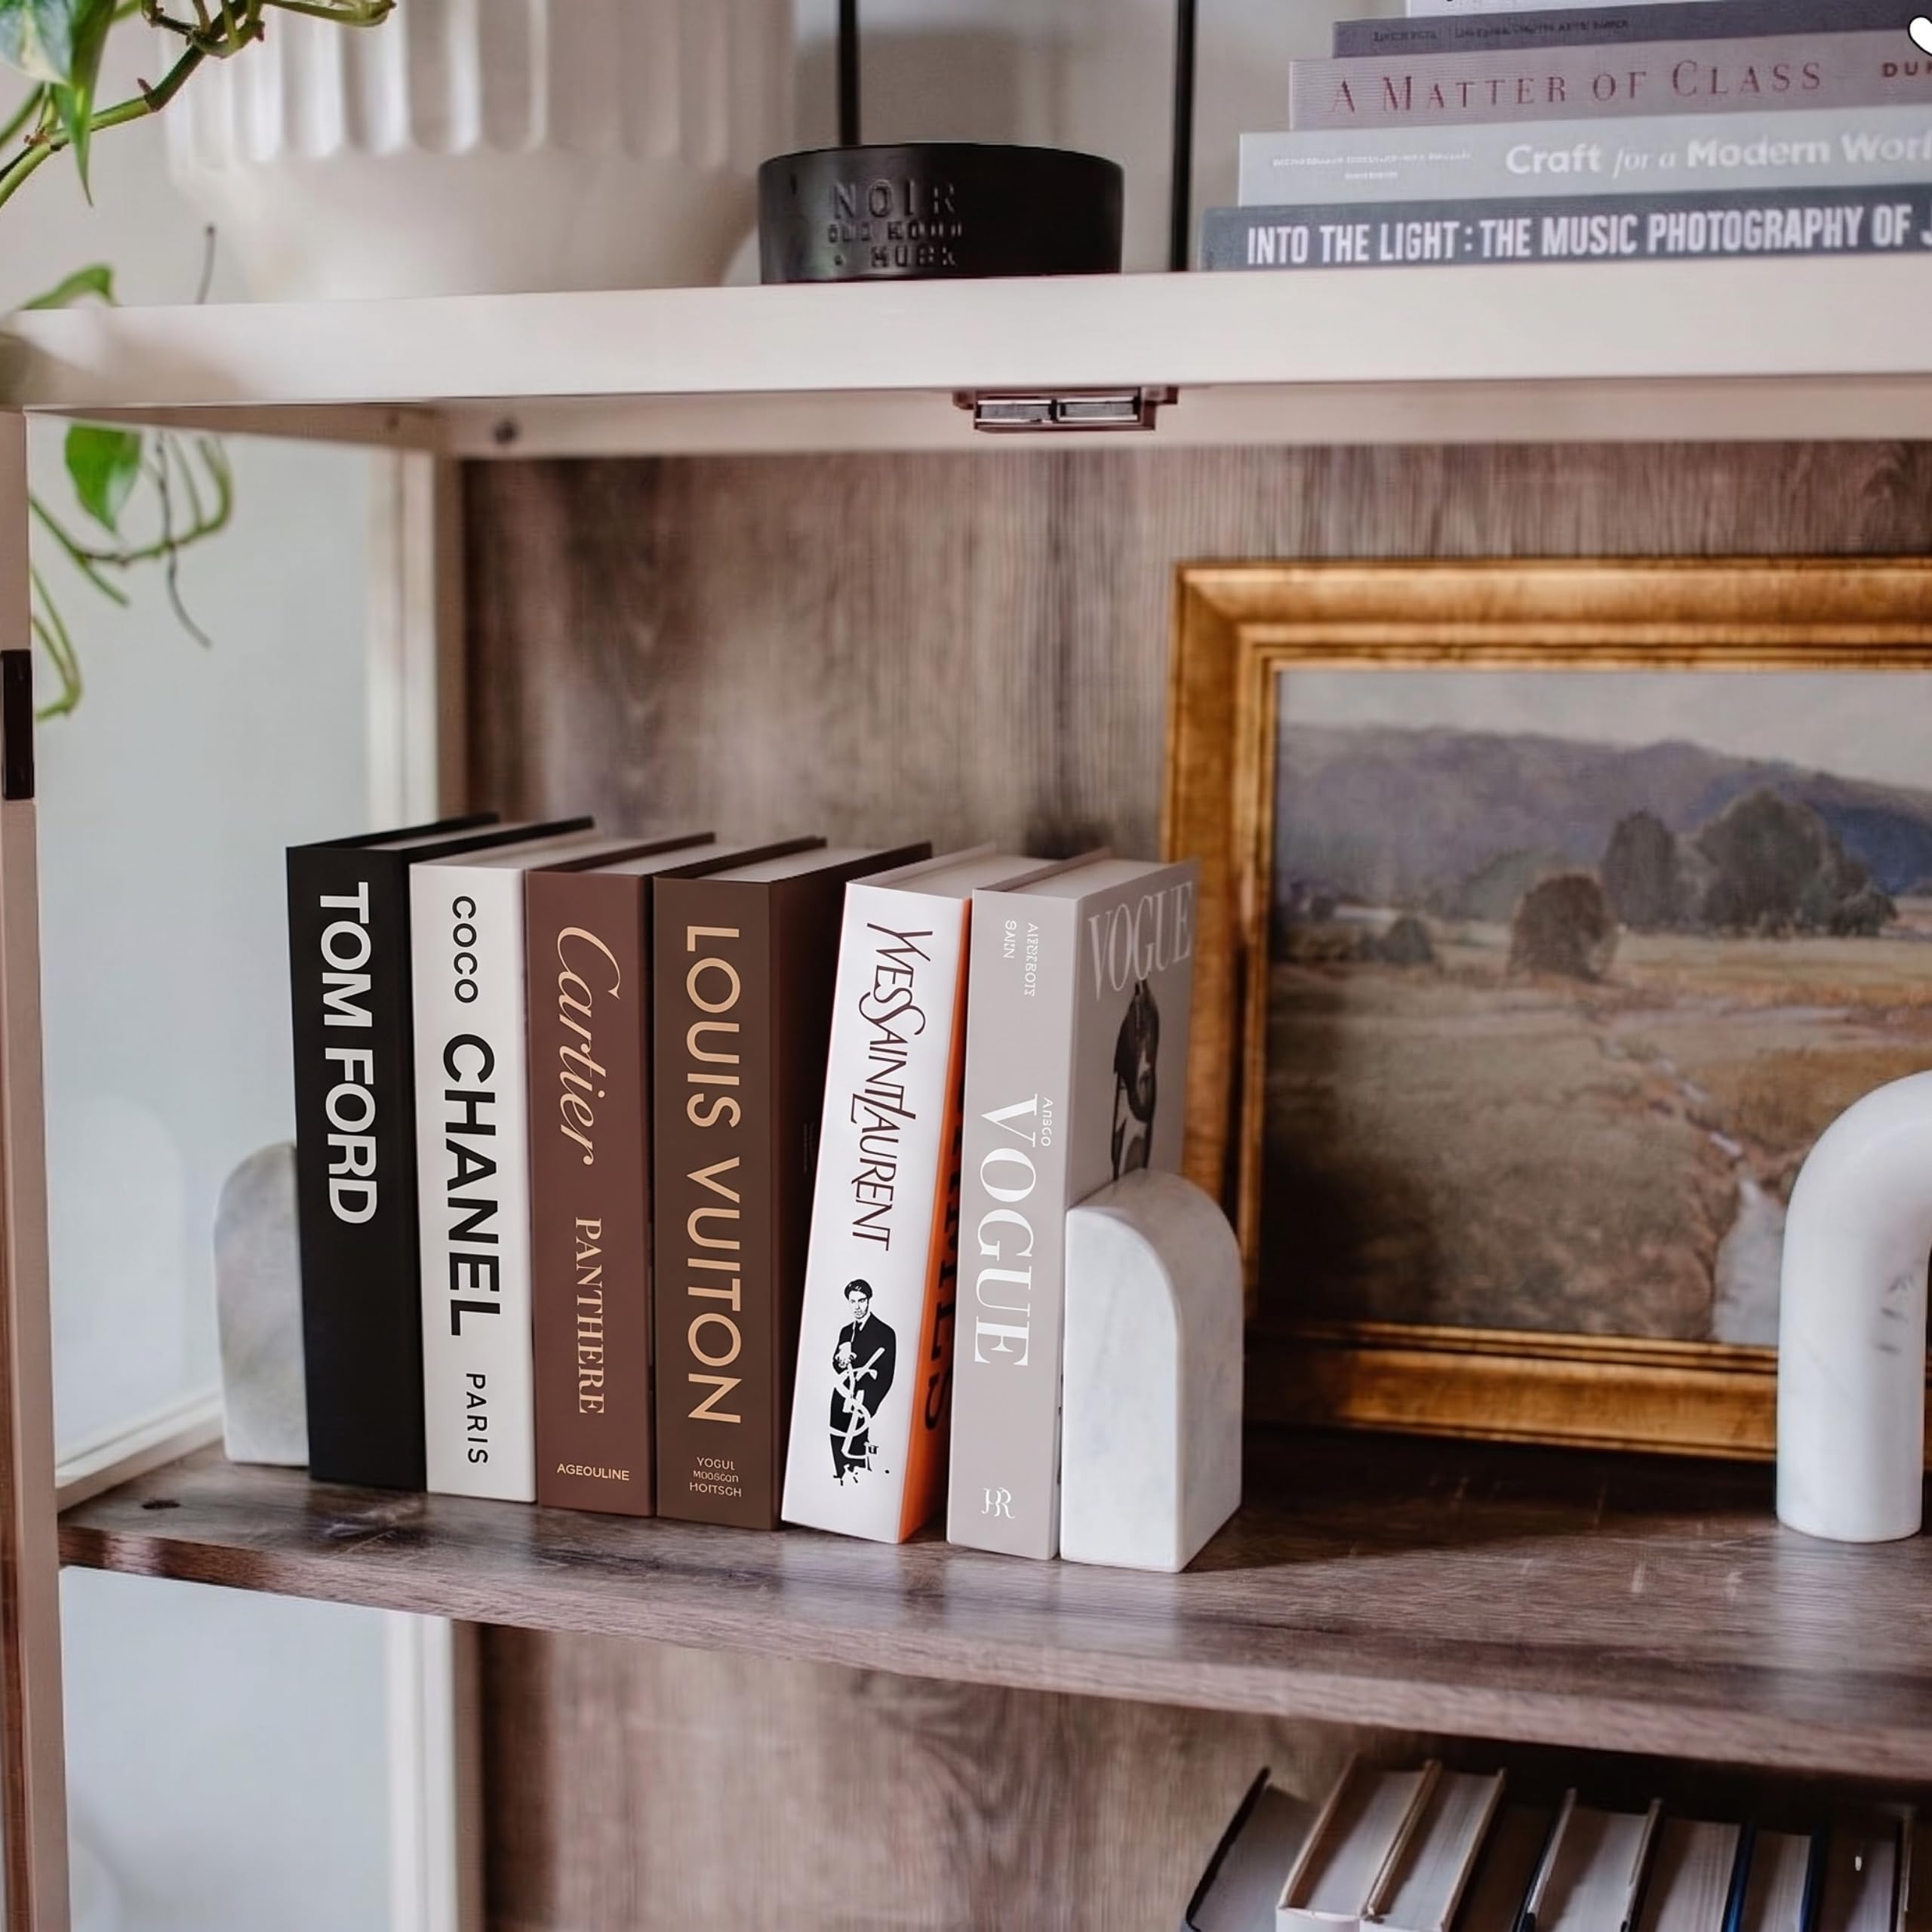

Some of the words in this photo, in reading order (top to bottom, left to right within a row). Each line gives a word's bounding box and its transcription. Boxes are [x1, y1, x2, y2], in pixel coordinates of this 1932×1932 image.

[1333, 79, 1355, 112] A
[1383, 75, 1566, 111] MATTER
[1672, 59, 1821, 97] CLASS
[832, 180, 955, 220] NOIR
[1506, 143, 1602, 174] Craft
[1612, 147, 1648, 179] for
[1658, 152, 1675, 169] a
[1687, 135, 1830, 168] Modern
[1247, 226, 1309, 264] INTO
[1319, 223, 1371, 263] THE
[1478, 217, 1531, 258] THE
[1541, 214, 1638, 256] MUSIC
[1647, 206, 1864, 253] PHOTOGRAPHY
[1872, 203, 1913, 248] OF
[319, 881, 373, 1027] TOM
[452, 896, 478, 1004] COCO
[1088, 881, 1193, 1001] VOGUE
[557, 926, 621, 1166] Cartier
[686, 925, 741, 1128] LOUIS
[325, 1048, 377, 1223] FORD
[443, 1033, 500, 1337] CHANEL
[687, 1156, 742, 1423] VUITON
[974, 1093, 1038, 1366] VOGUE
[574, 1217, 605, 1414] PANTHERE
[465, 1373, 489, 1464] PARIS
[556, 1463, 630, 1481] AGEOULINE
